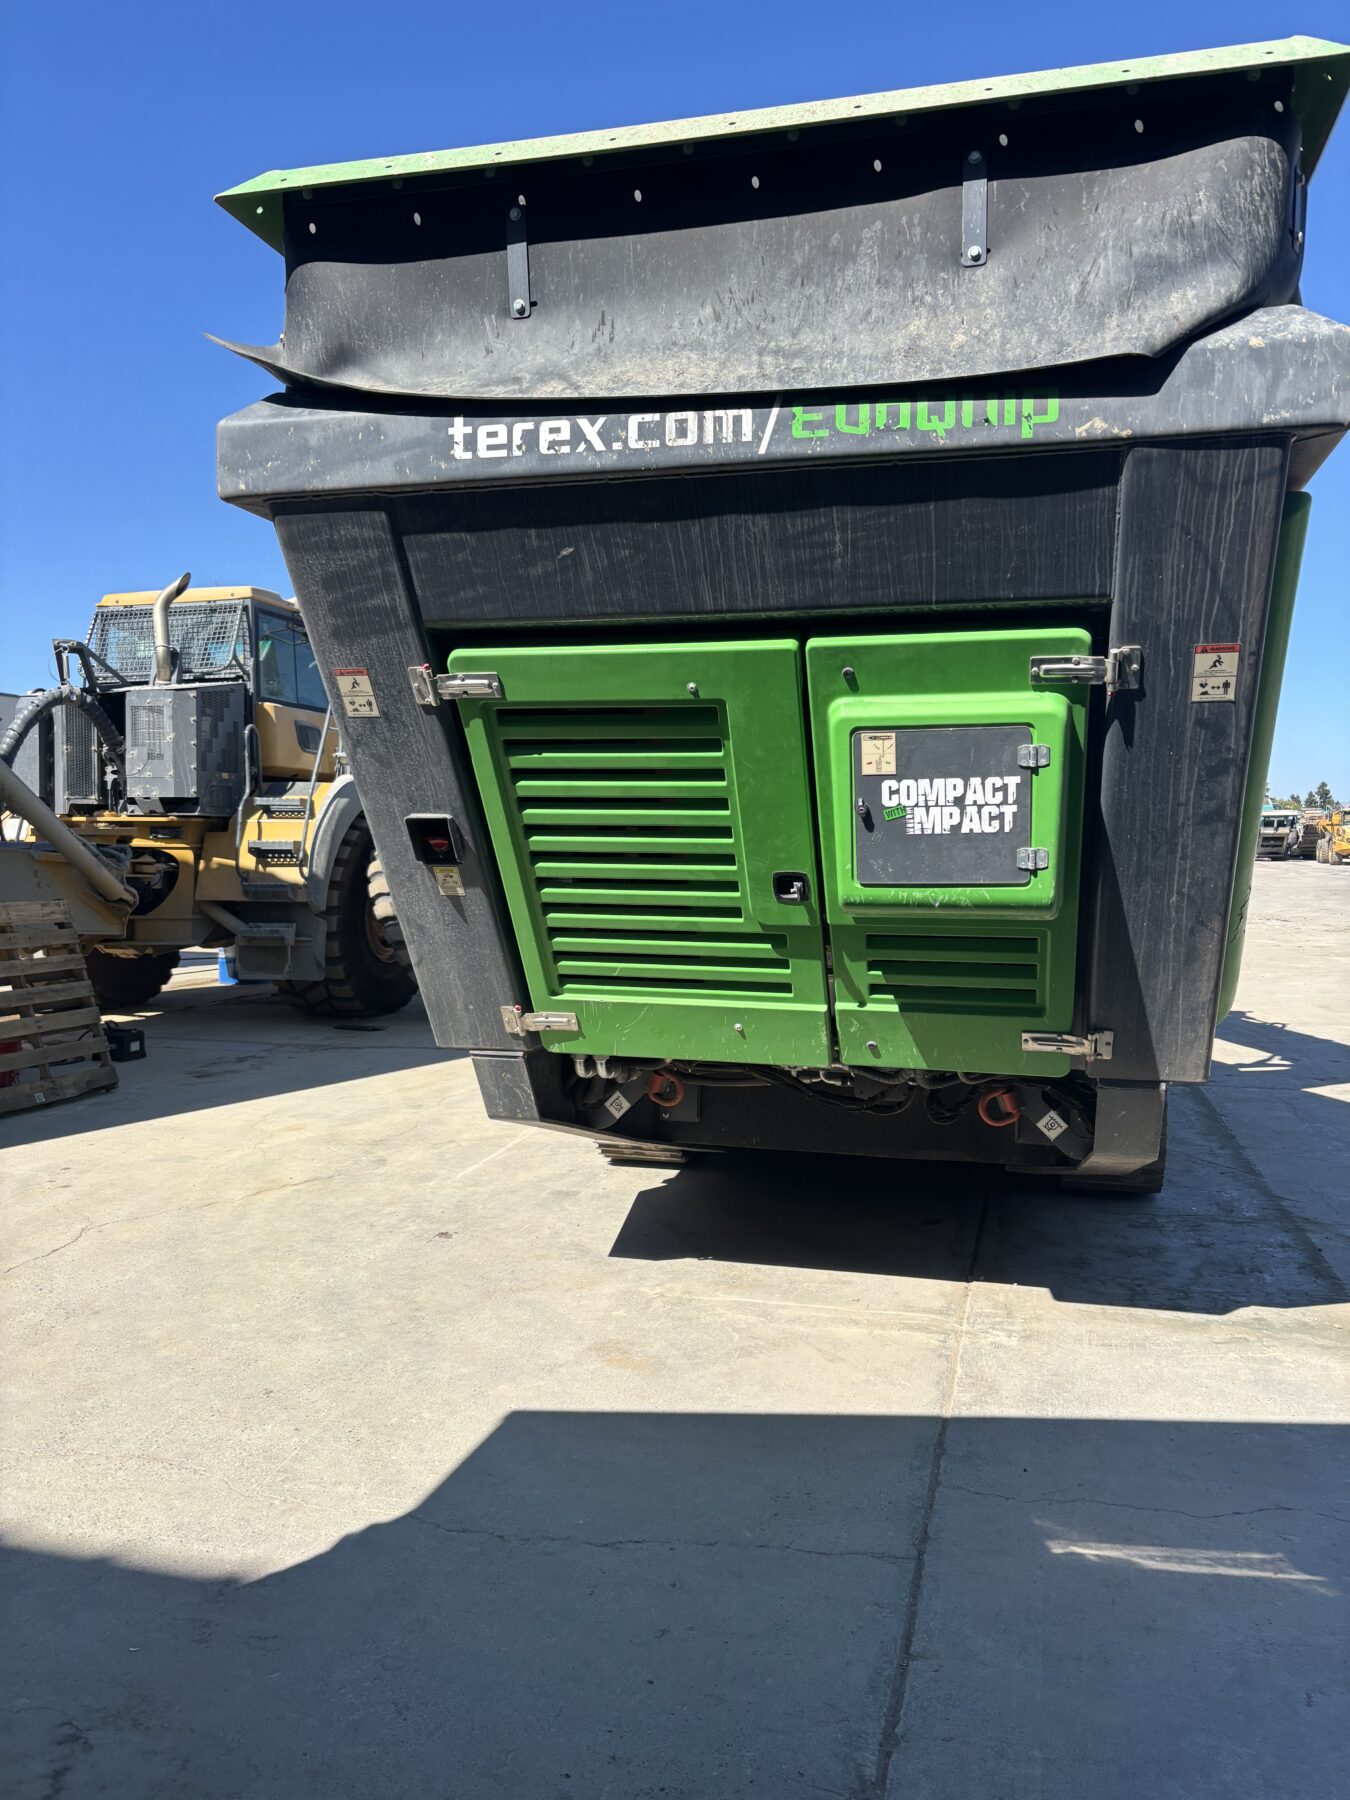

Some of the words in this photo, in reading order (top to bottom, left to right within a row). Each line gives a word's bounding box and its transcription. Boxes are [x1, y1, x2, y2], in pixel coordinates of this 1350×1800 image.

[881, 776, 1021, 807] COMPACT
[883, 805, 908, 821] WITH
[906, 805, 1017, 834] IMPACT
